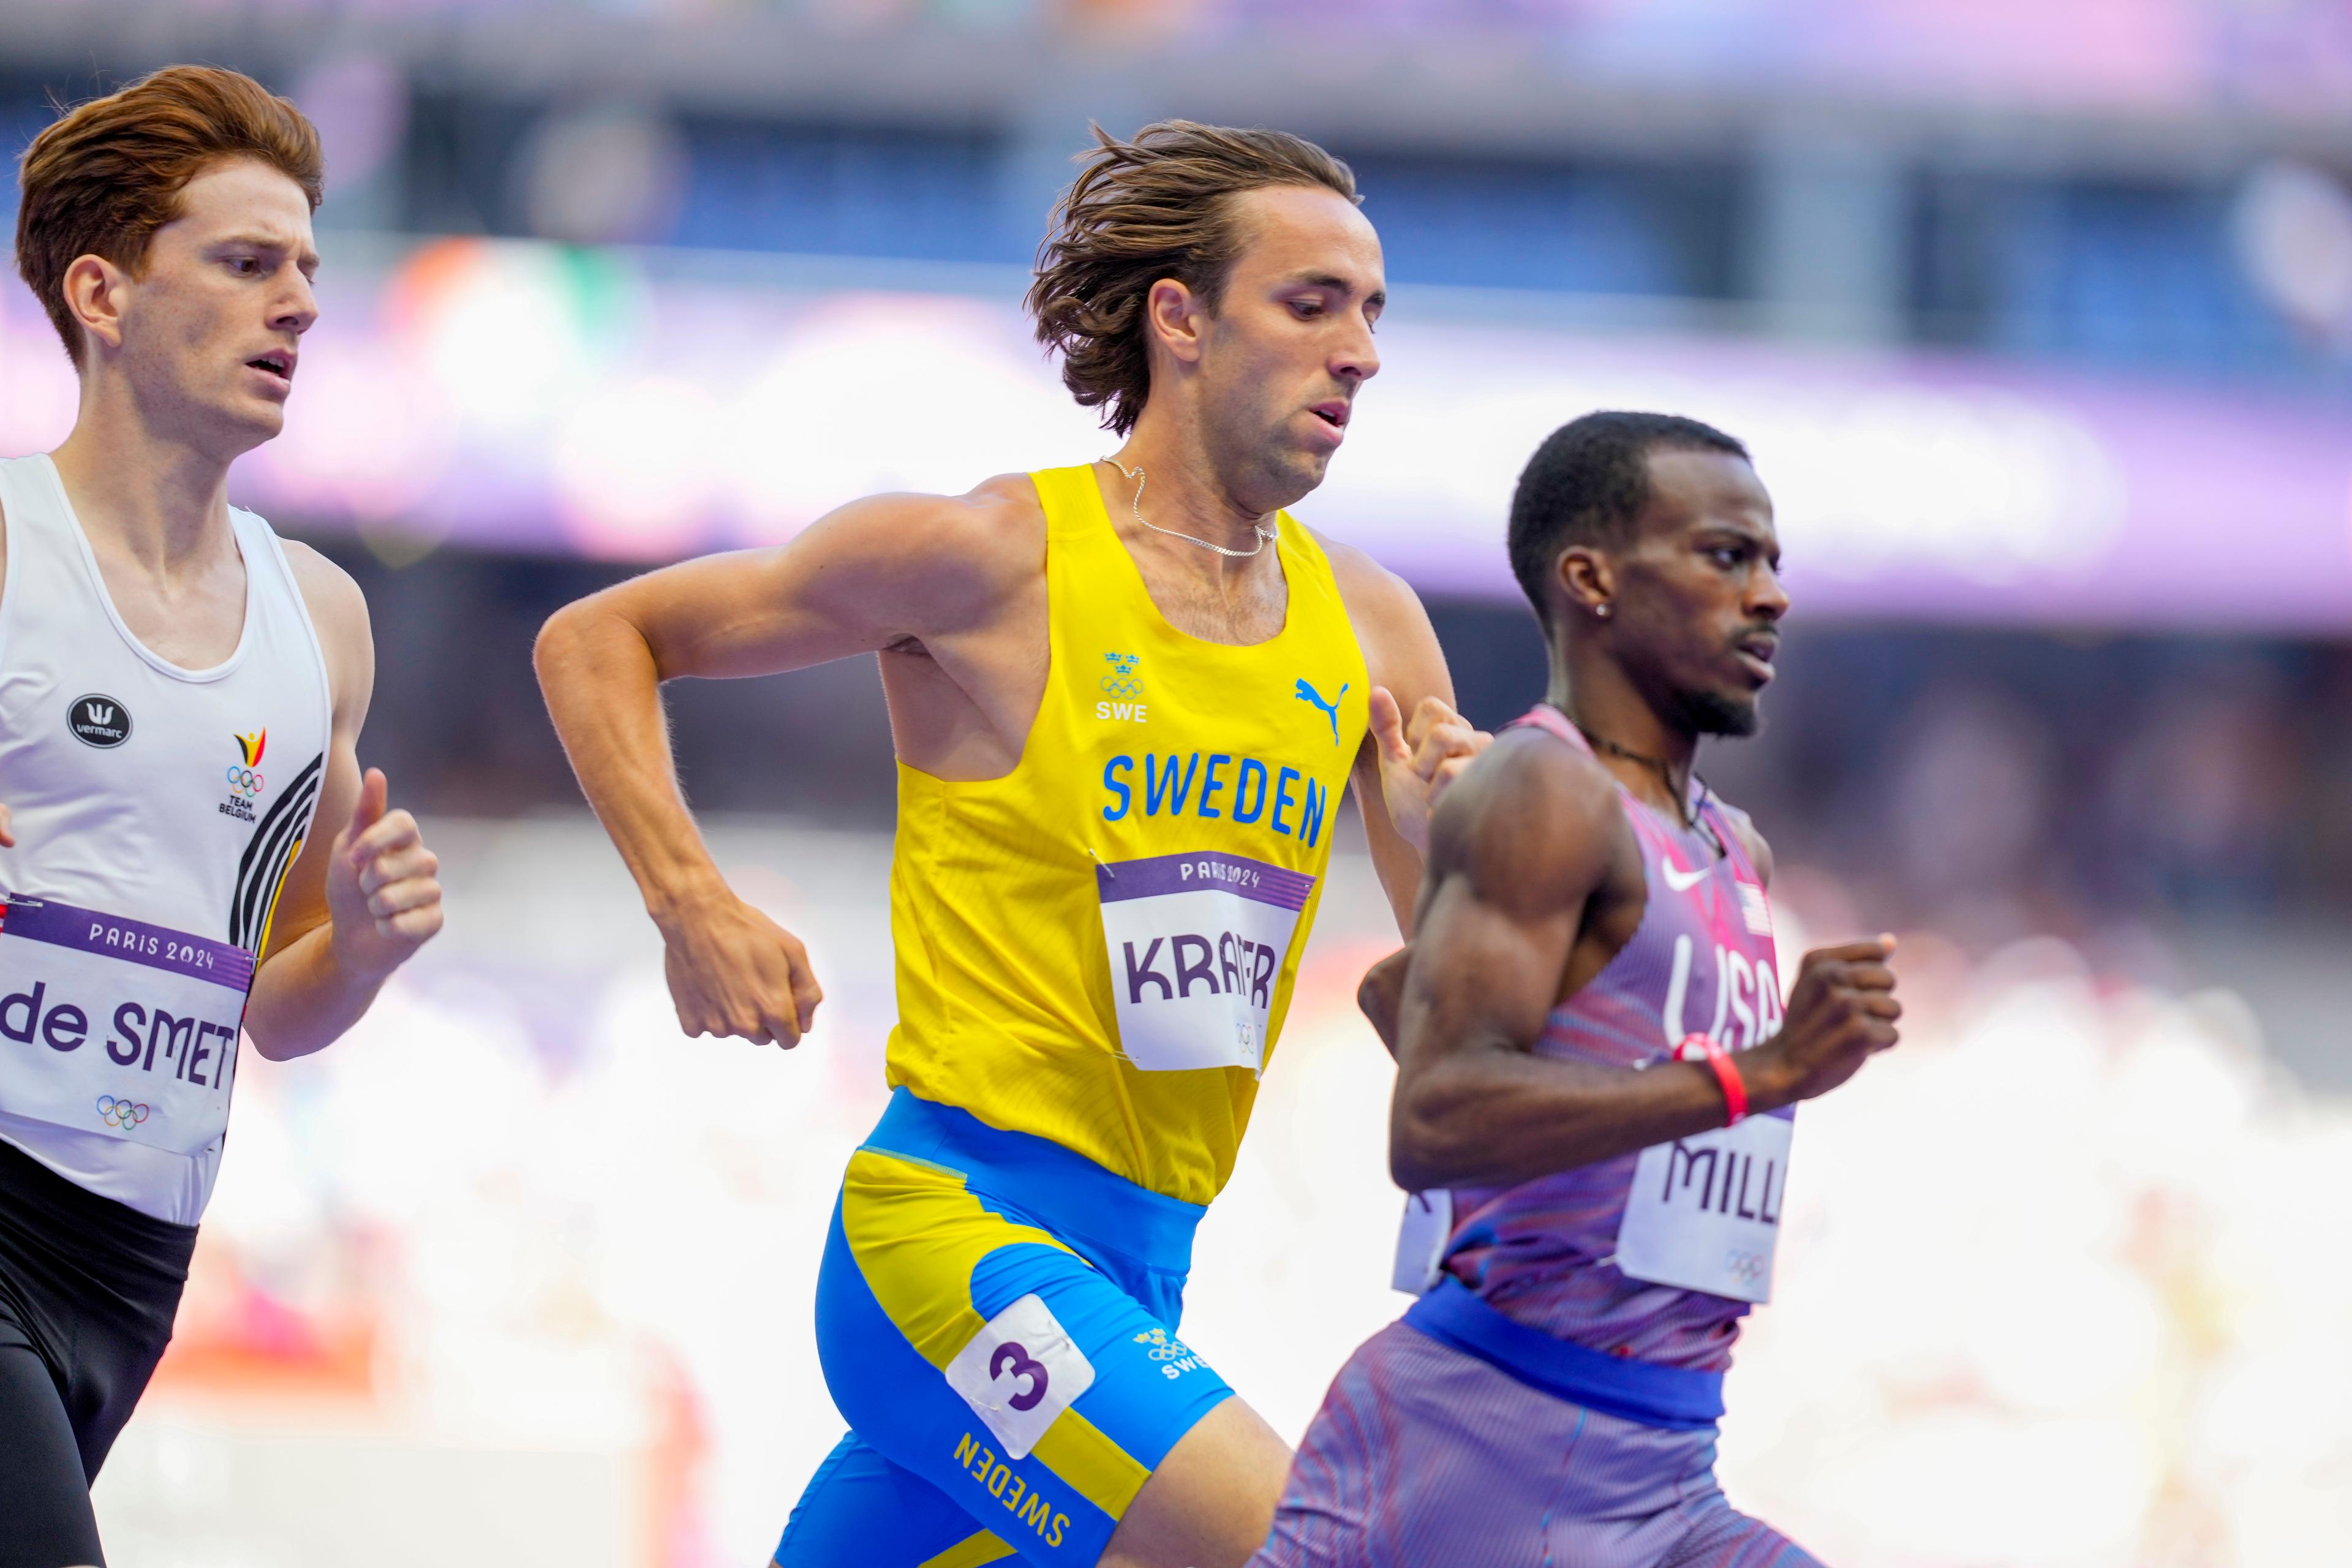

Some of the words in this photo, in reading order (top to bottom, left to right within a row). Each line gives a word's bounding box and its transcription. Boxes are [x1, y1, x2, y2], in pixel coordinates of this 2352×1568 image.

[76, 723, 123, 739] vermarc
[1096, 701, 1147, 723] SWE
[219, 804, 257, 824] BELGIUM
[229, 795, 253, 811] TEAM
[1102, 753, 1326, 848] SWEDEN
[1227, 865, 1260, 888] 2024
[89, 923, 159, 954] PARIS
[165, 941, 214, 969] 2024
[1663, 933, 1784, 1061] USA
[0, 981, 88, 1052] de
[107, 1002, 235, 1089] SMET
[1662, 1139, 1785, 1224] MILL
[990, 1342, 1049, 1411] 3
[1161, 1355, 1210, 1380] SWE
[954, 1432, 1071, 1547] SWEDEN
